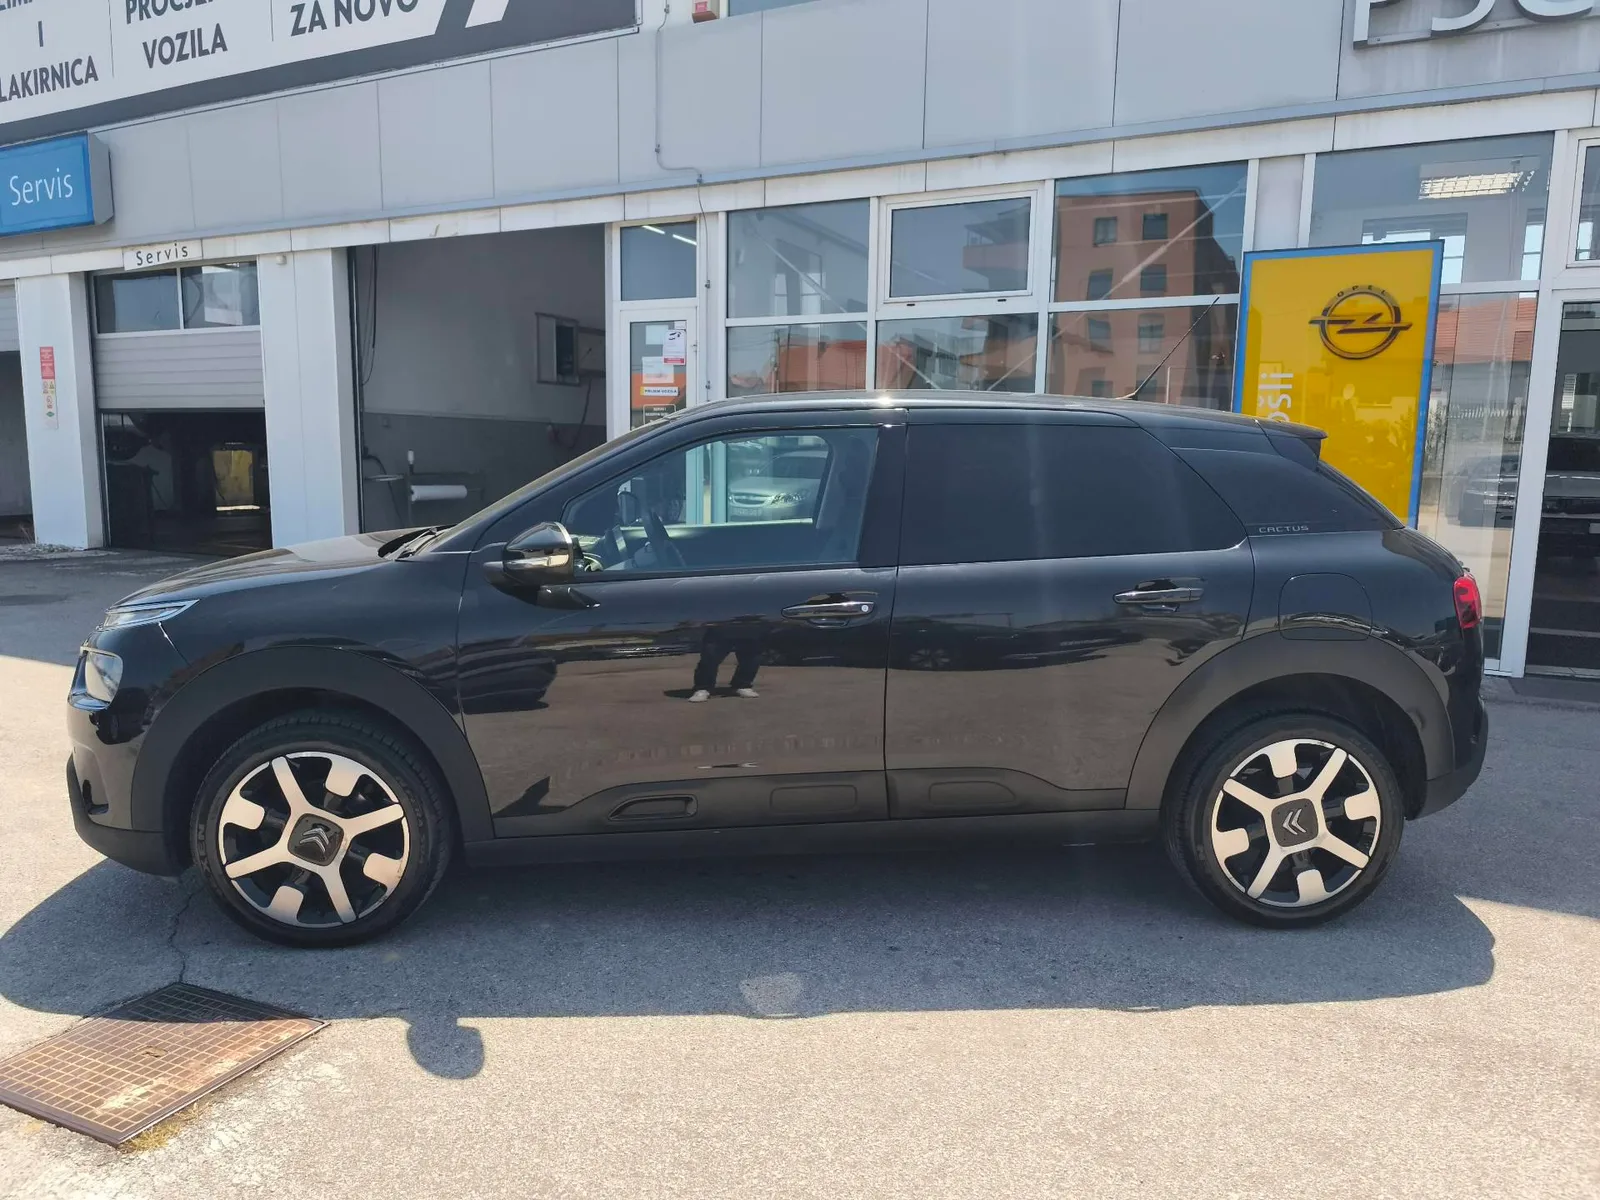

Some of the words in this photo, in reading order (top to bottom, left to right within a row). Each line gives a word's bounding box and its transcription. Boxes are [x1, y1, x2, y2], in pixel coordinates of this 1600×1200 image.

[290, 0, 328, 37] ZA
[37, 20, 45, 48] I
[142, 22, 229, 69] VOZILA
[9, 167, 74, 206] Servis
[136, 243, 189, 266] Servis
[1336, 284, 1387, 299] OPEL
[1258, 525, 1309, 534] CACTUS
